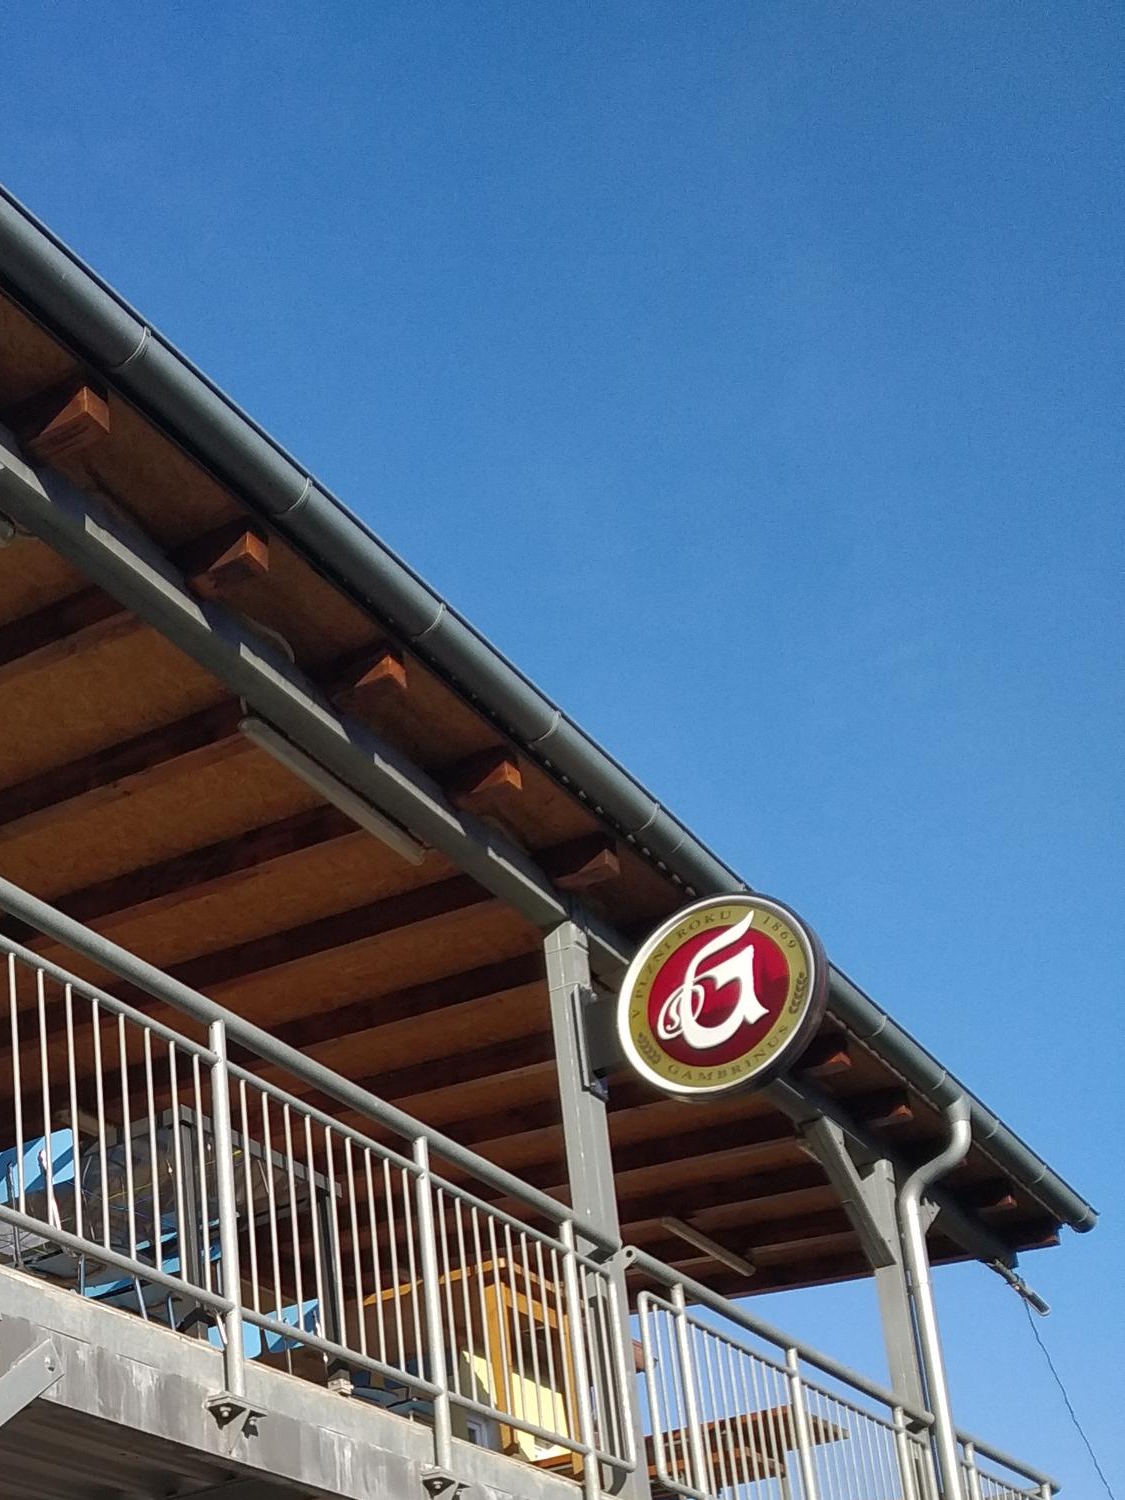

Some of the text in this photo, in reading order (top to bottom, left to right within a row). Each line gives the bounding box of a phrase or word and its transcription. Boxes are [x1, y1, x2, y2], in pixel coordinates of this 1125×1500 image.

[677, 910, 732, 939] ROKU
[762, 915, 798, 950] 1869
[667, 1025, 789, 1082] GAMBRINUS
